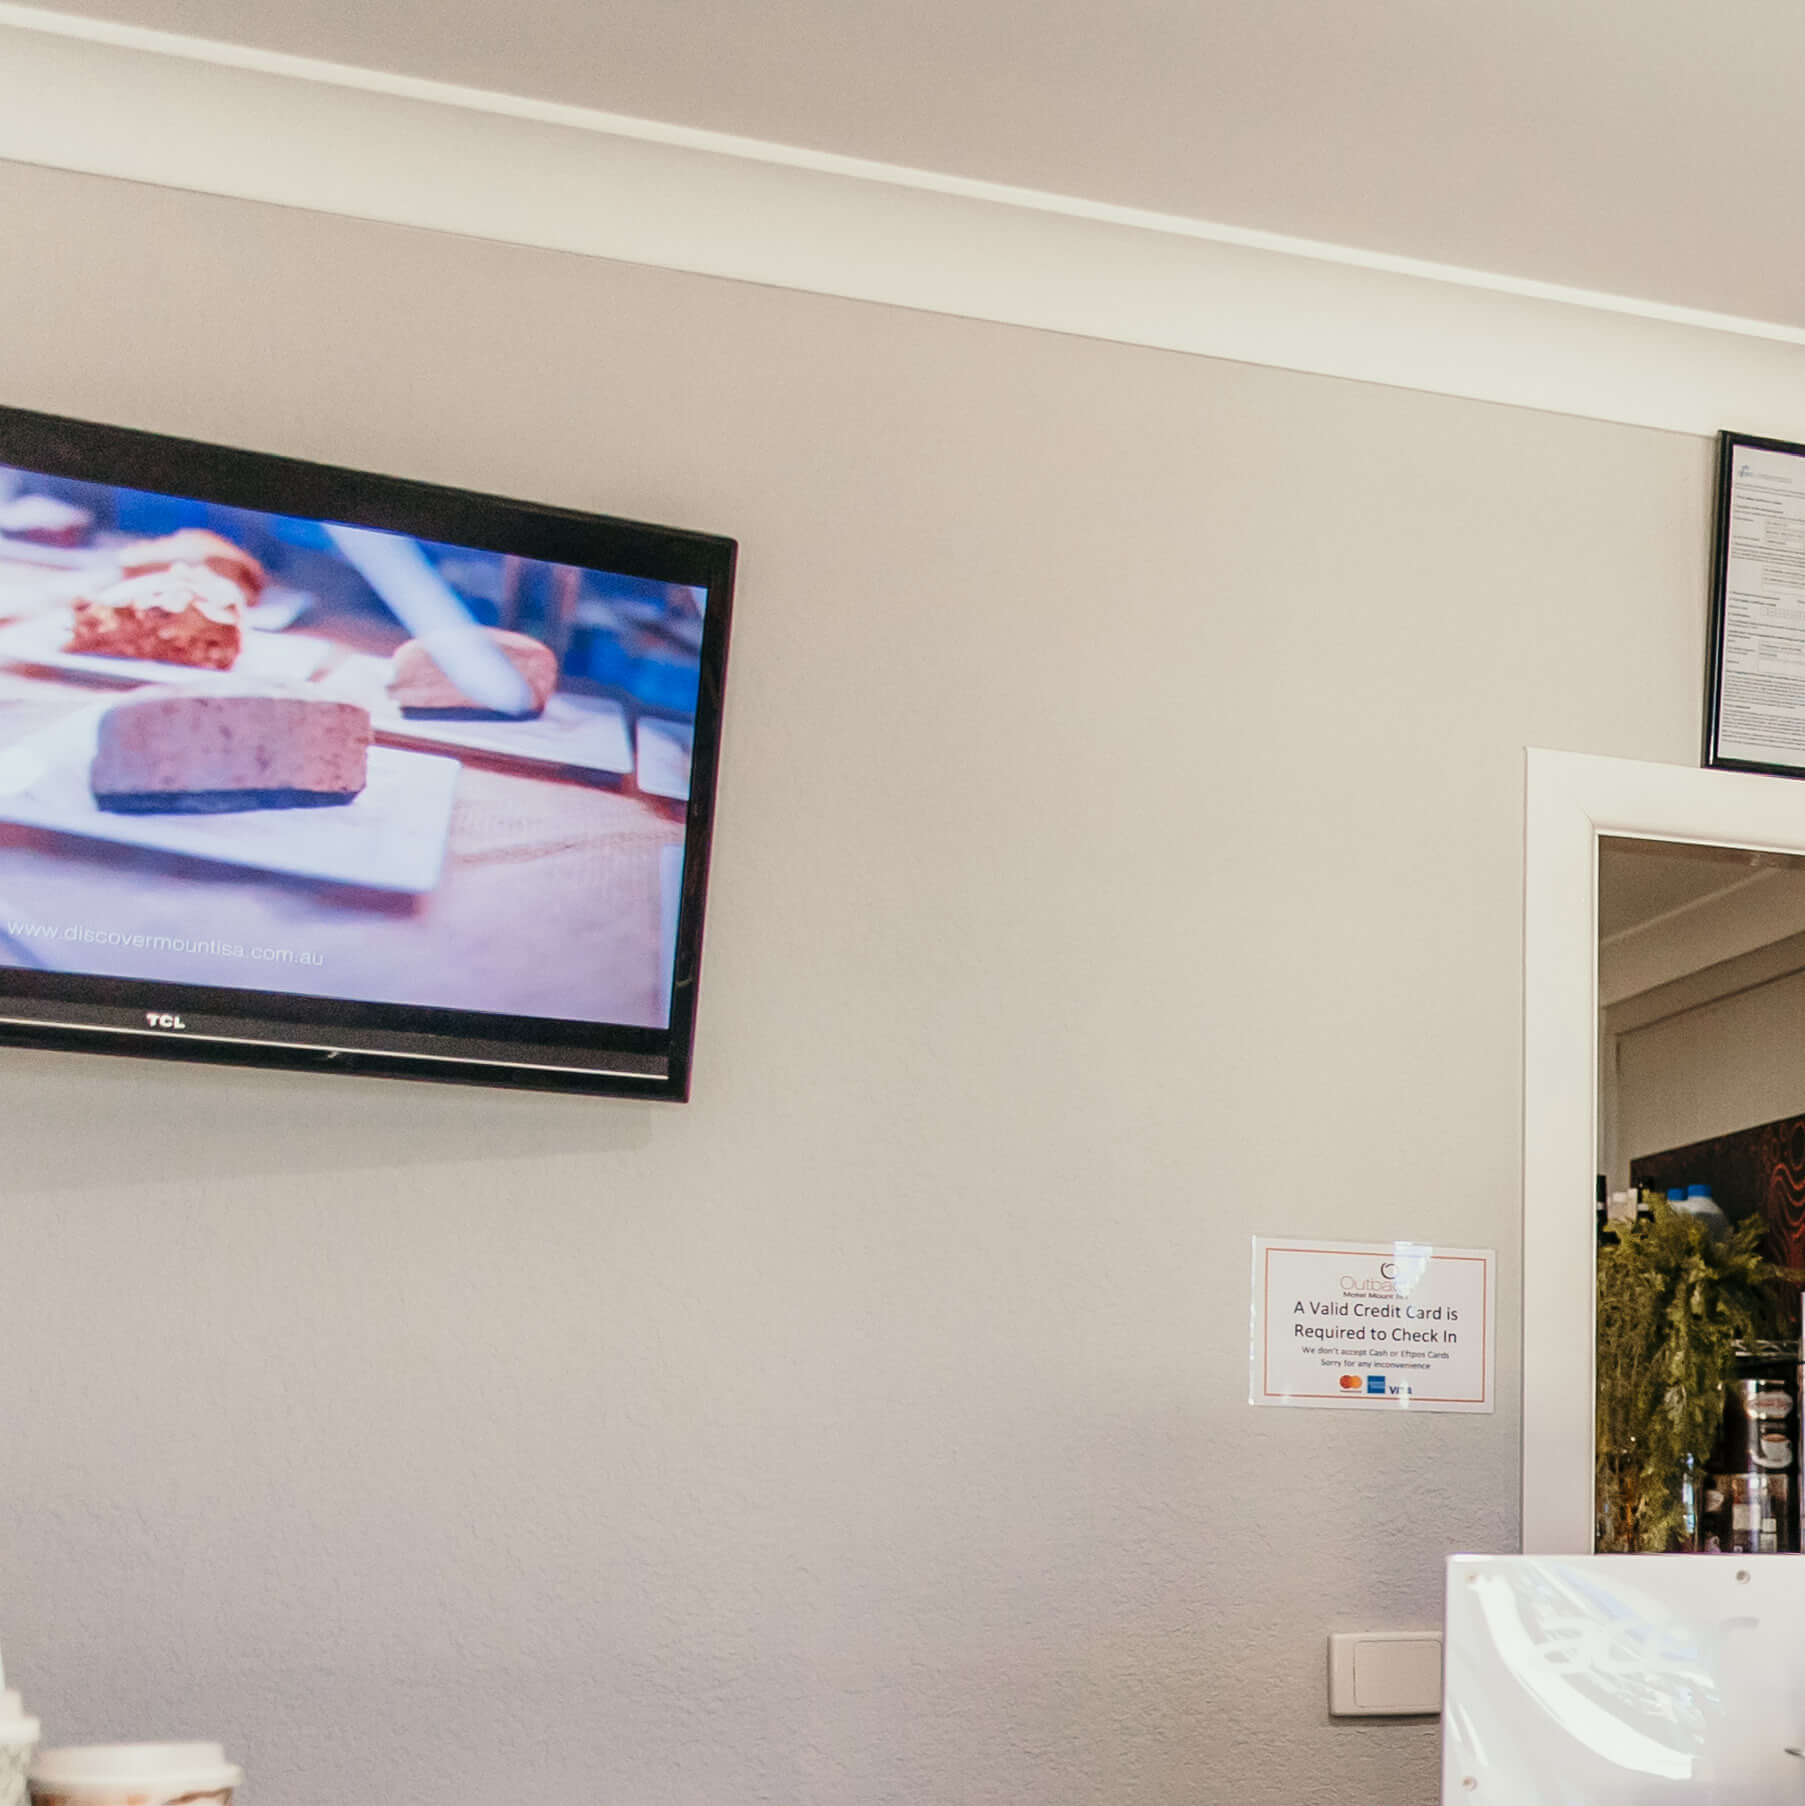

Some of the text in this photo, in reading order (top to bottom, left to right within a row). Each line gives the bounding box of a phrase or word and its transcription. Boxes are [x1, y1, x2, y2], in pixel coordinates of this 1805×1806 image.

[7, 920, 324, 967] www.discovermountisa.com.au
[147, 1012, 186, 1030] TCL
[1293, 1301, 1459, 1321] A Valid Credit Card is
[1294, 1323, 1458, 1344] Required to Check In
[1301, 1346, 1315, 1355] We
[1318, 1346, 1339, 1355] don't
[1341, 1349, 1367, 1358] accept
[1369, 1349, 1390, 1357] Cash
[1427, 1351, 1450, 1360] Cards
[1320, 1359, 1431, 1370] Sorry for any inconvenience
